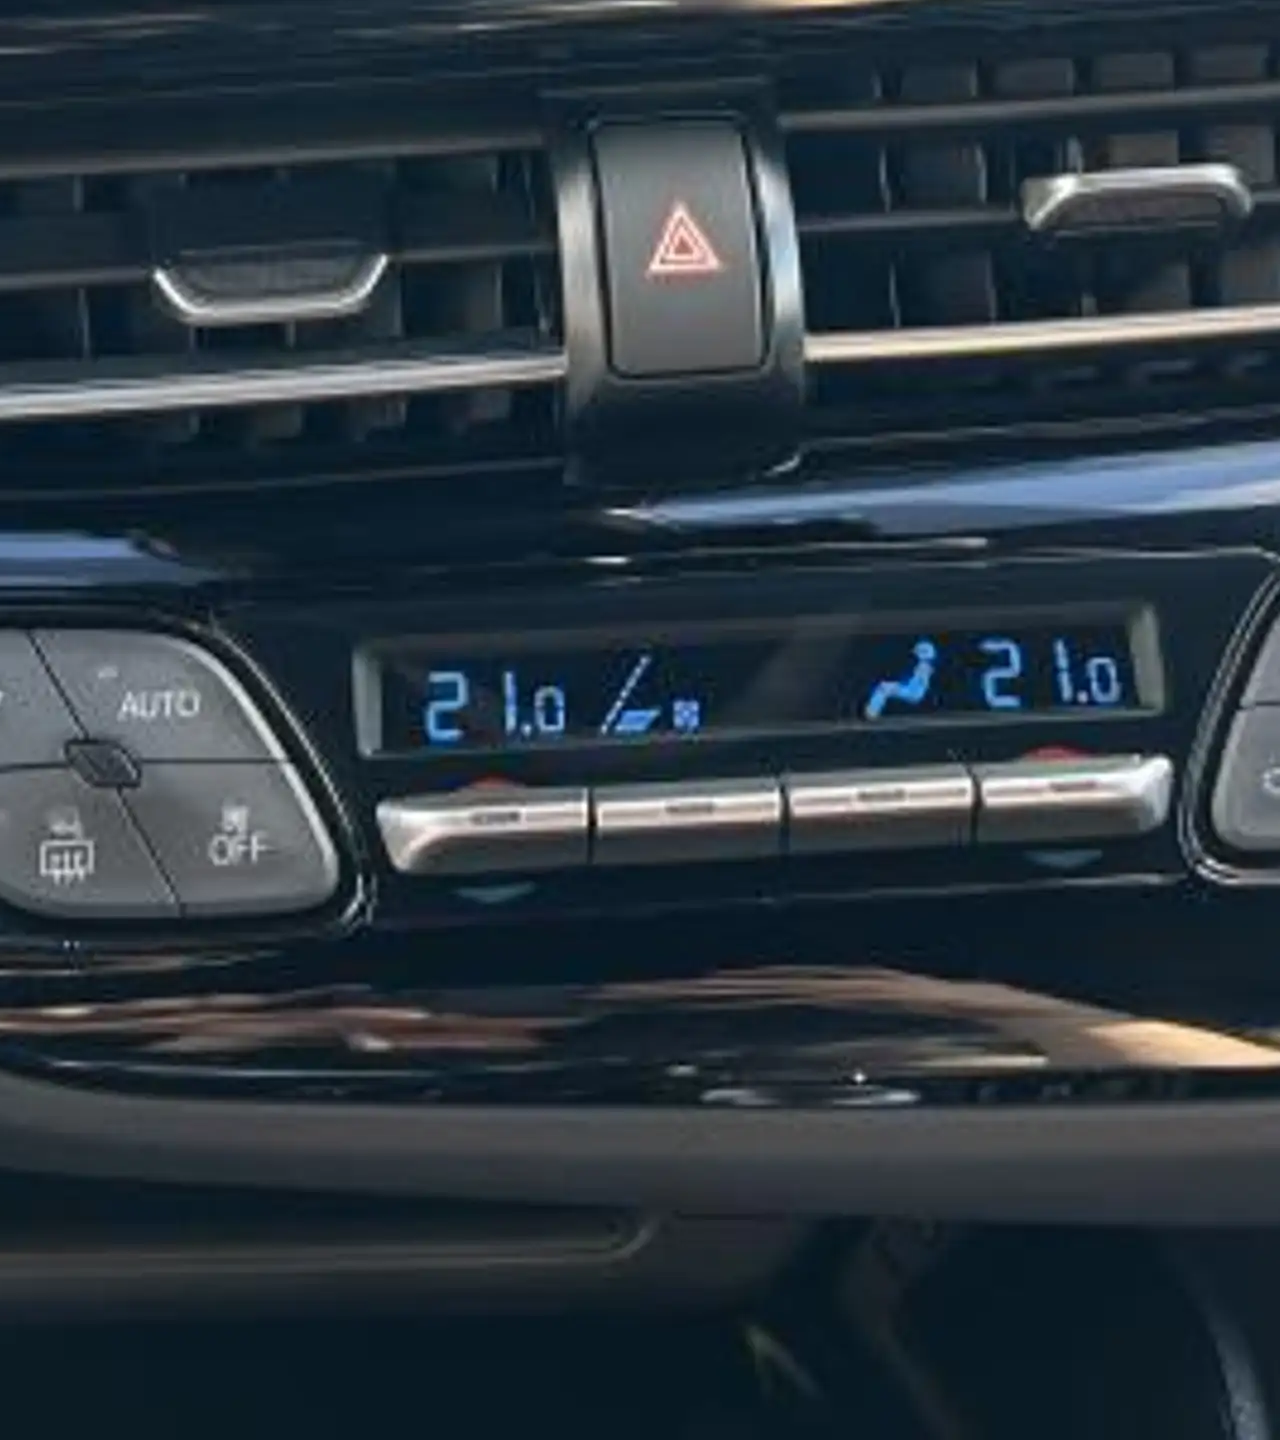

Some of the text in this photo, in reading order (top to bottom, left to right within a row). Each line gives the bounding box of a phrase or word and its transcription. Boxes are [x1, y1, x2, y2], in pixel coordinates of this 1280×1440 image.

[978, 639, 1122, 708] 21.0
[117, 687, 202, 723] AUTO
[424, 670, 566, 741] 21.0
[208, 830, 271, 867] OFF
